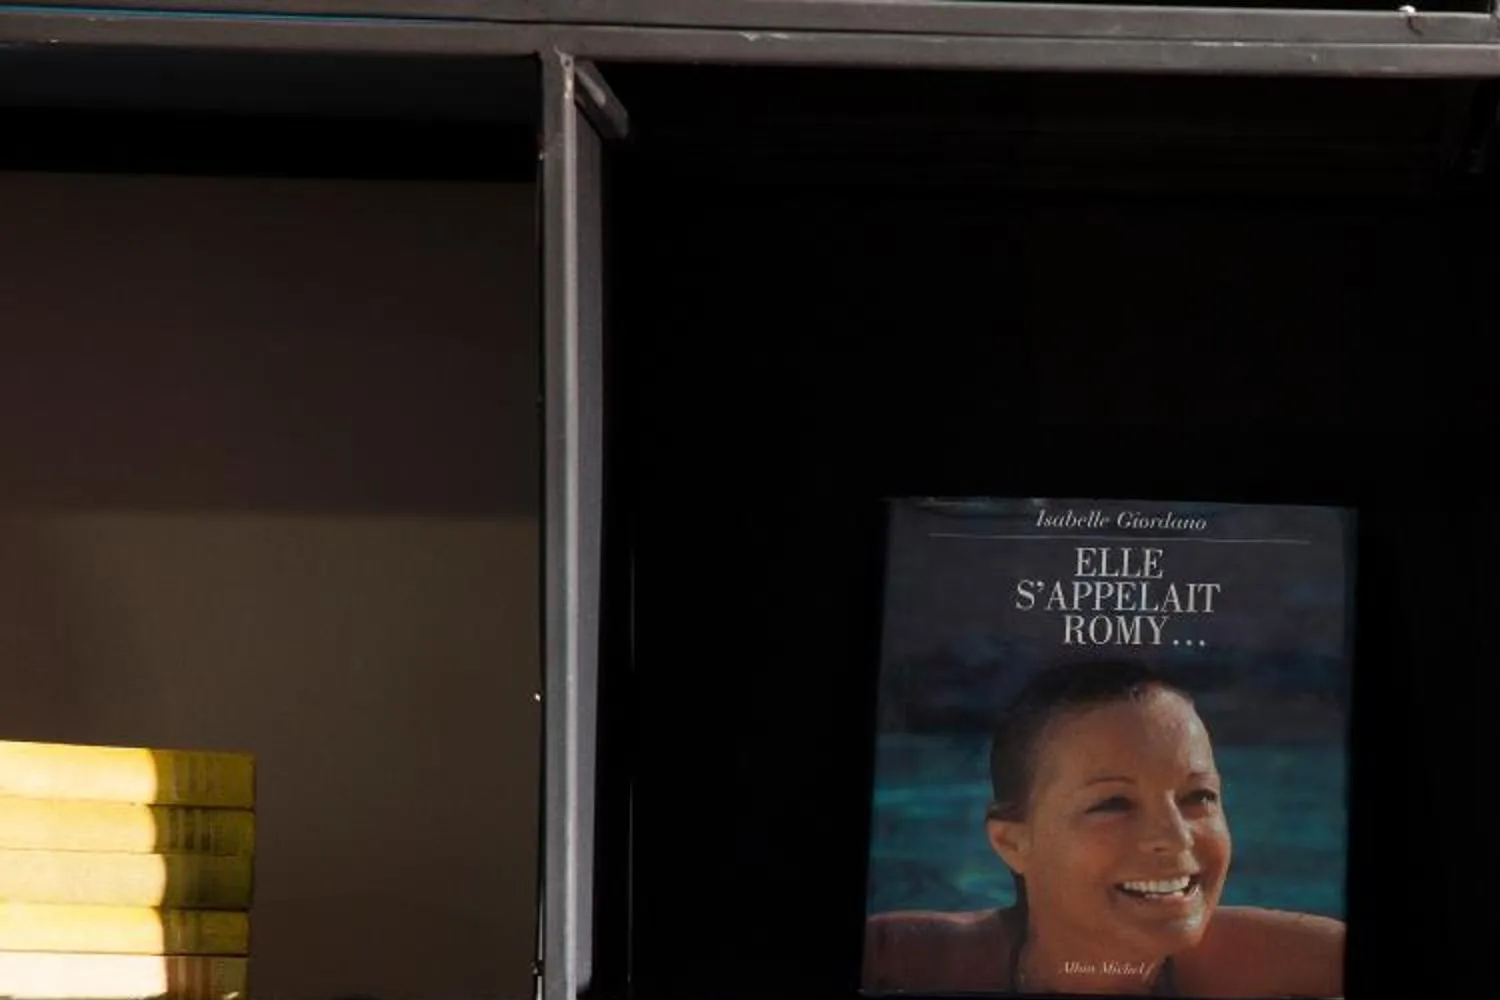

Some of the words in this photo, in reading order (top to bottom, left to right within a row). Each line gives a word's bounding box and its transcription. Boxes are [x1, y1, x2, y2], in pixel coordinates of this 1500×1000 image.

[1036, 509, 1110, 528] Isabelle
[1116, 511, 1207, 530] Giordano
[1074, 547, 1164, 579] ELLE
[1015, 579, 1222, 613] S'APPELAIT
